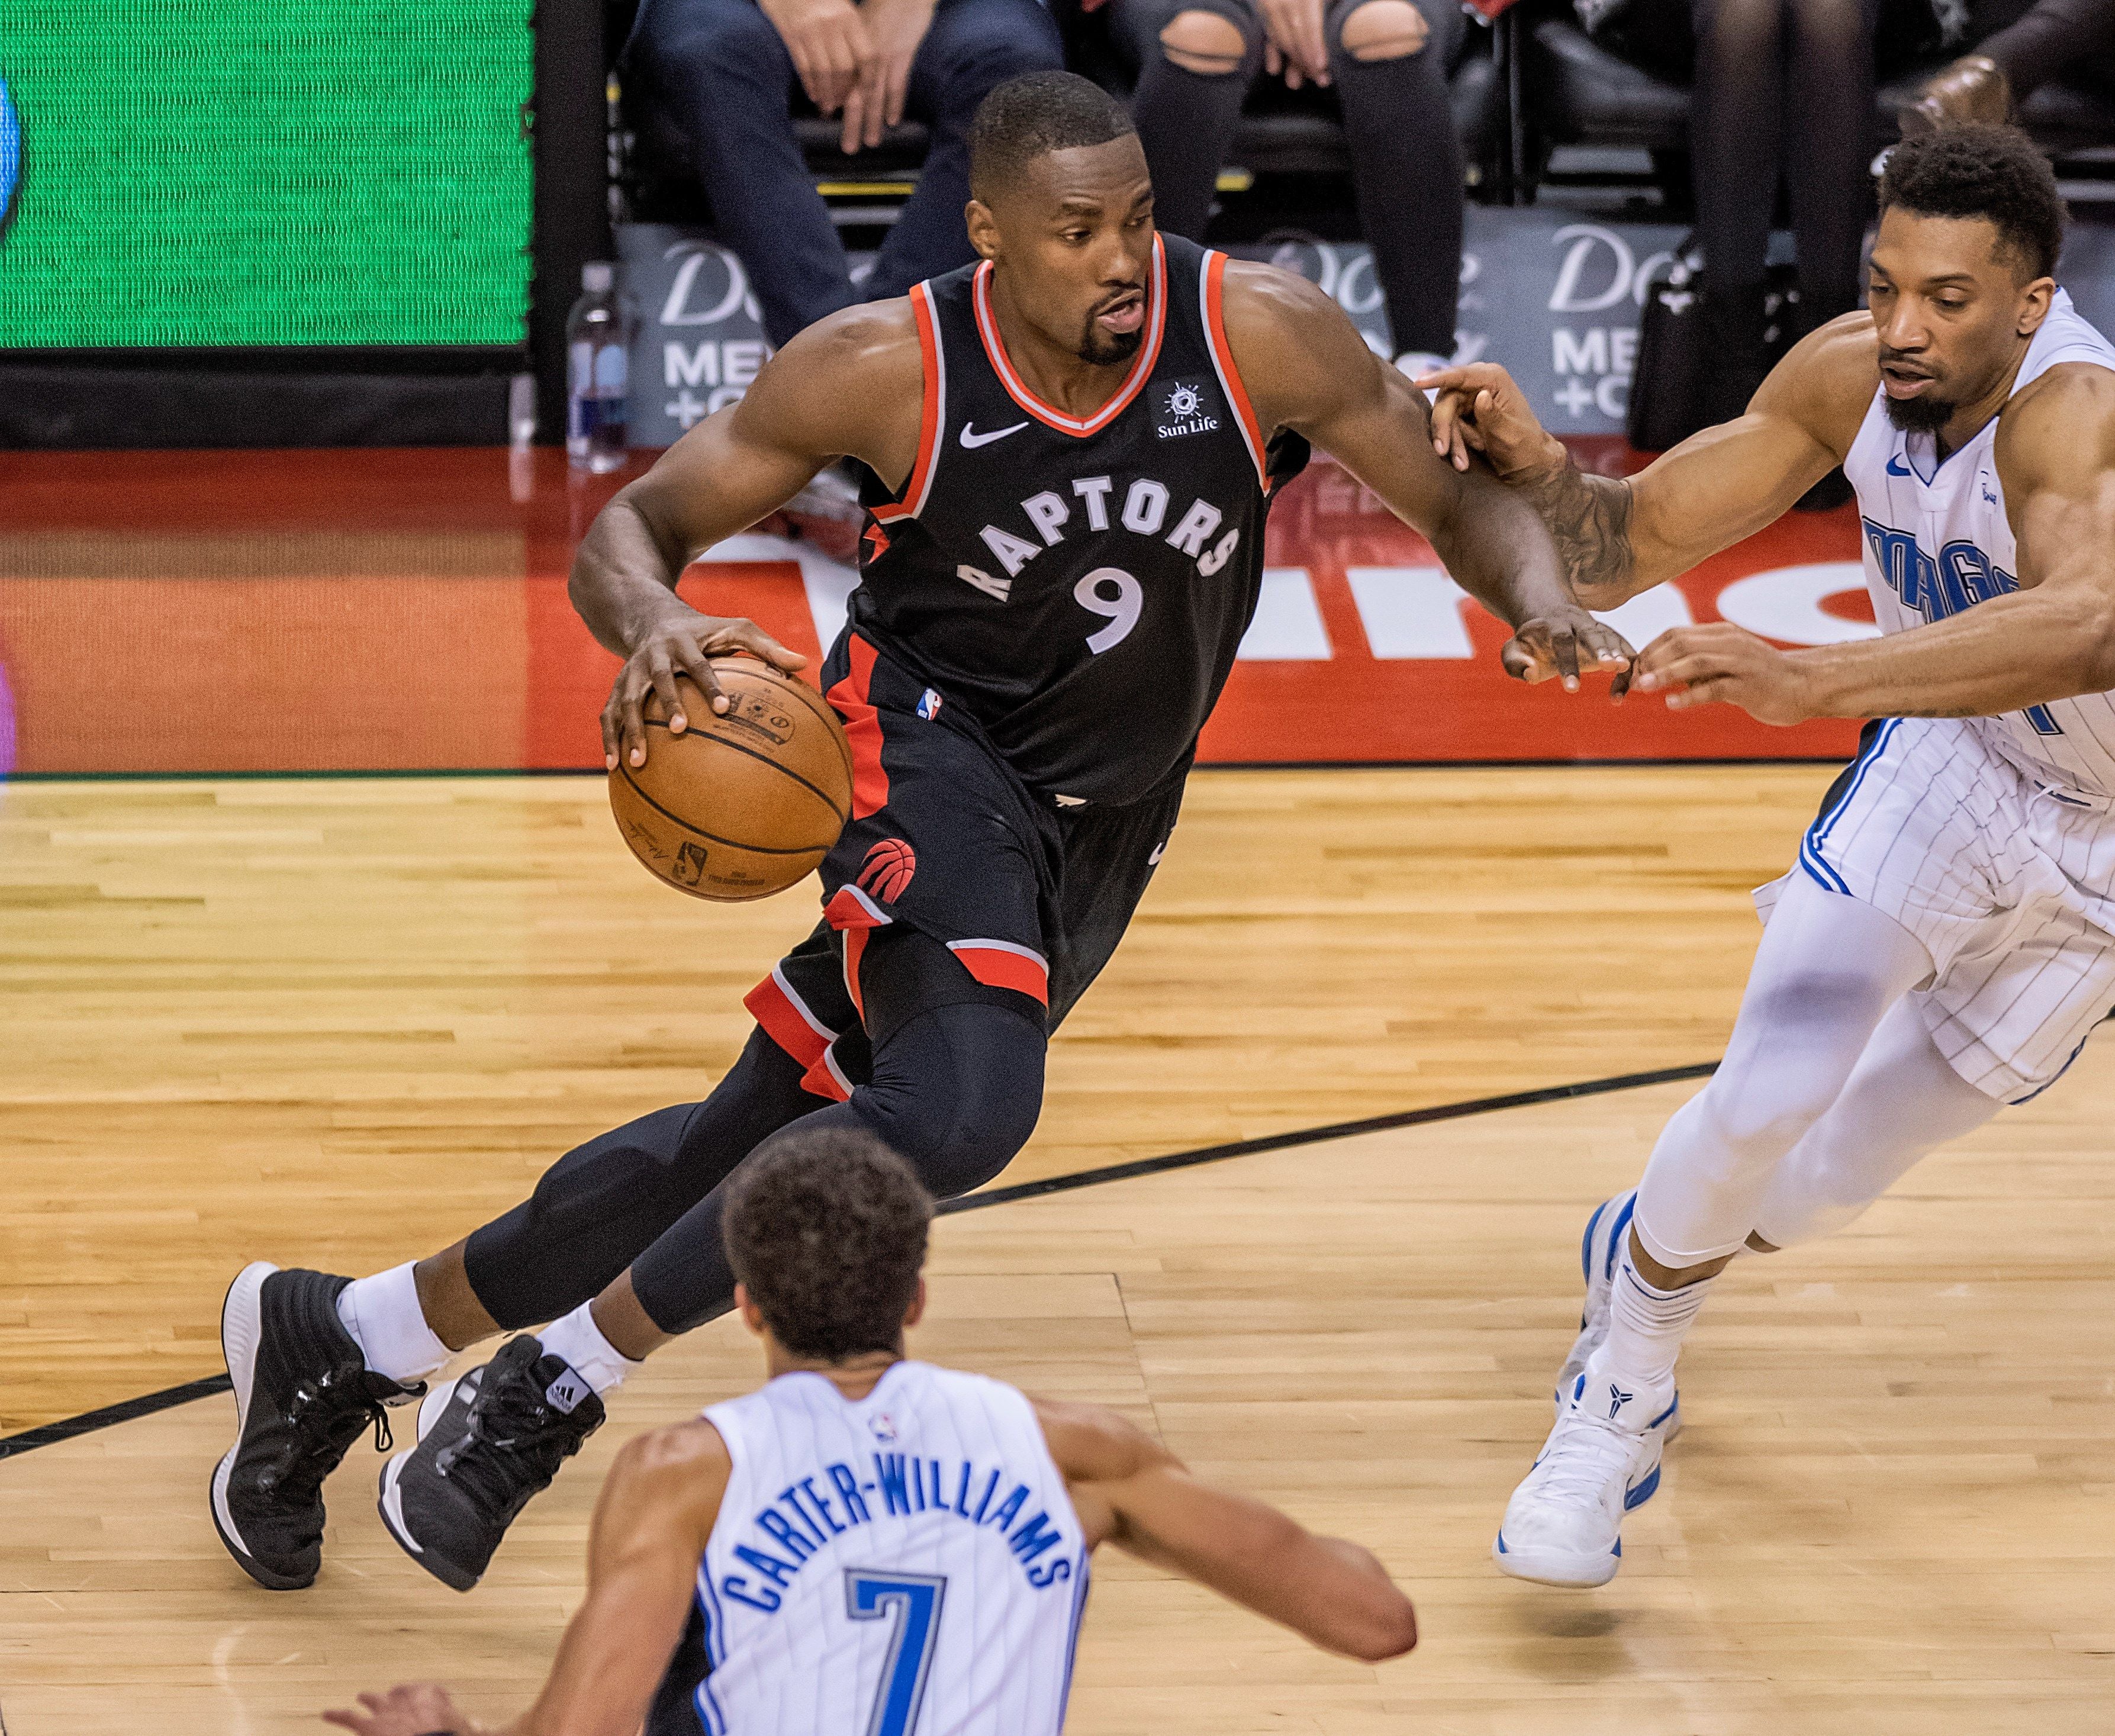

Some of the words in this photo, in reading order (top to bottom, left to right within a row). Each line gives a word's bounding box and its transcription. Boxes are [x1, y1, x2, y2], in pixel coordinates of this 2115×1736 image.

[663, 342, 774, 387] ME
[1158, 426, 1187, 439] Sun
[1189, 416, 1218, 433] Life
[956, 475, 1240, 603] RAPTORS
[1073, 566, 1144, 655] 9
[720, 1452, 1071, 1615] CARTER-WILLIAMS
[842, 1567, 948, 1736] 7
